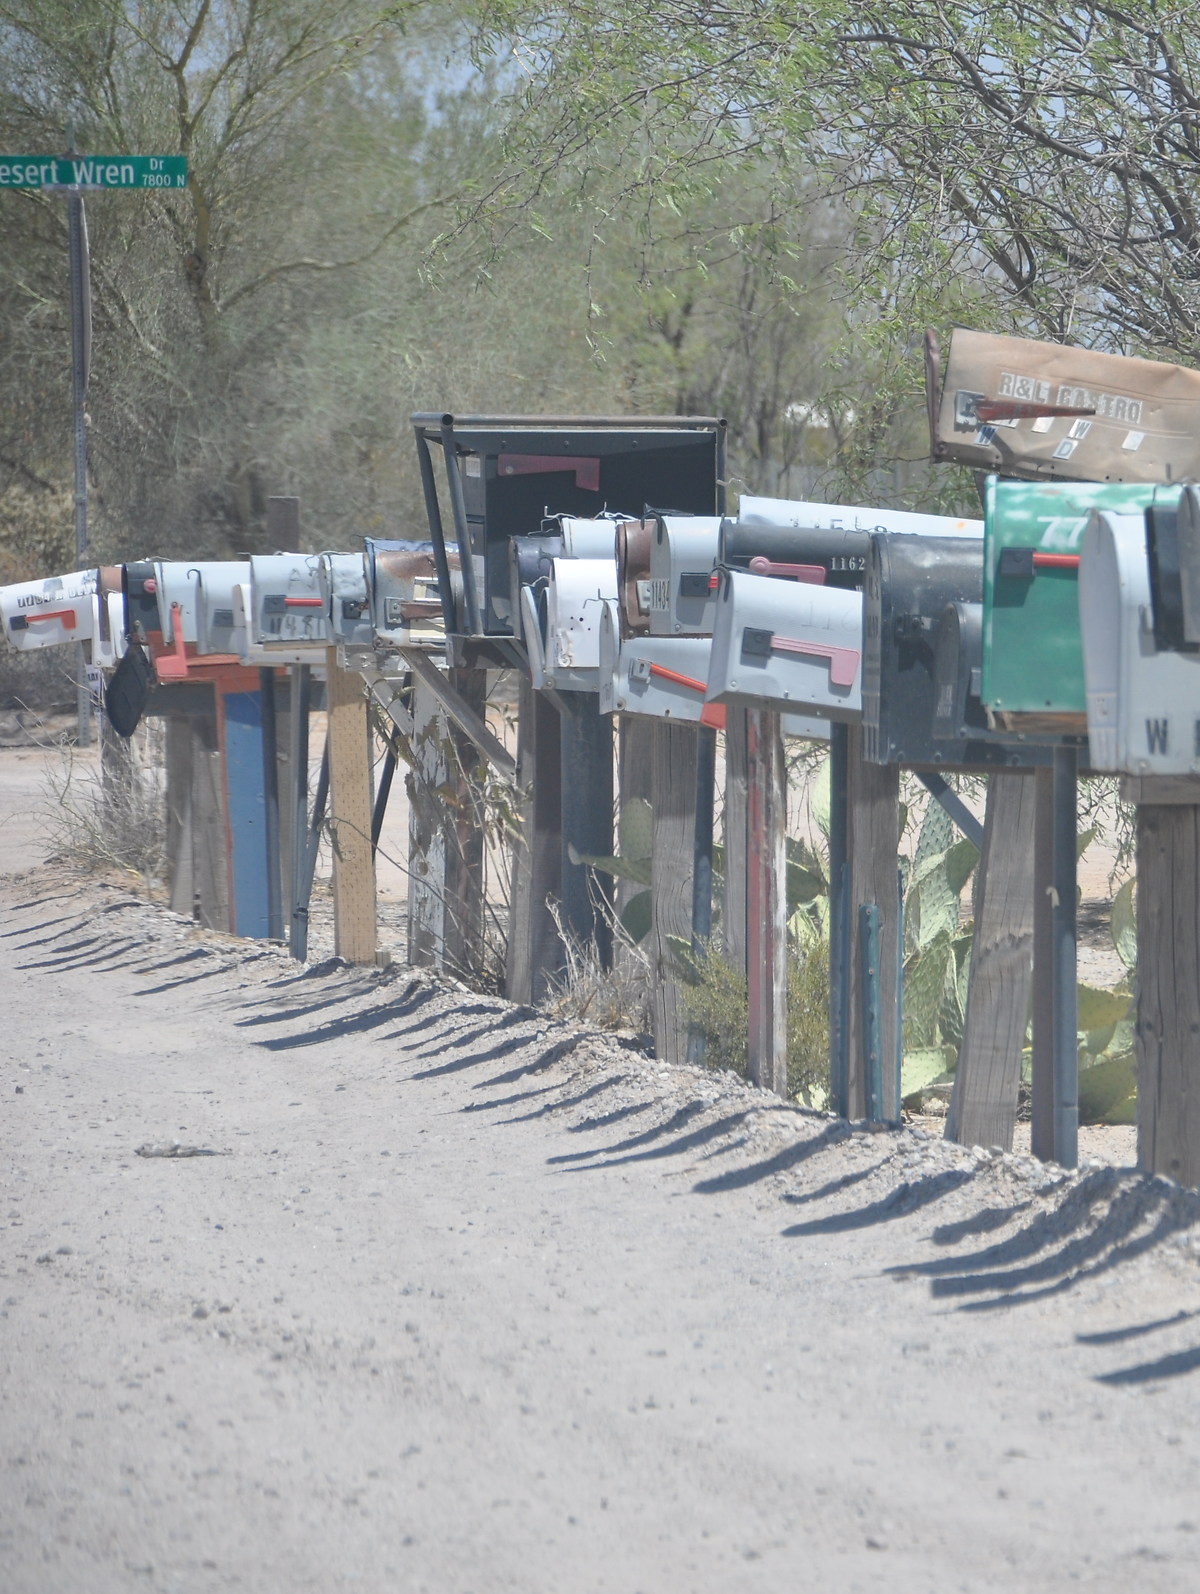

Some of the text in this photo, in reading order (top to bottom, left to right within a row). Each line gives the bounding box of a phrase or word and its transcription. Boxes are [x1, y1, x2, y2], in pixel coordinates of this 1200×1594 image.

[72, 161, 135, 185] Wren
[150, 158, 164, 171] Dr
[142, 174, 186, 187] 7800 N
[1000, 374, 1140, 422] R&L CASTRO
[831, 556, 865, 571] 1162
[1146, 718, 1168, 755] W
